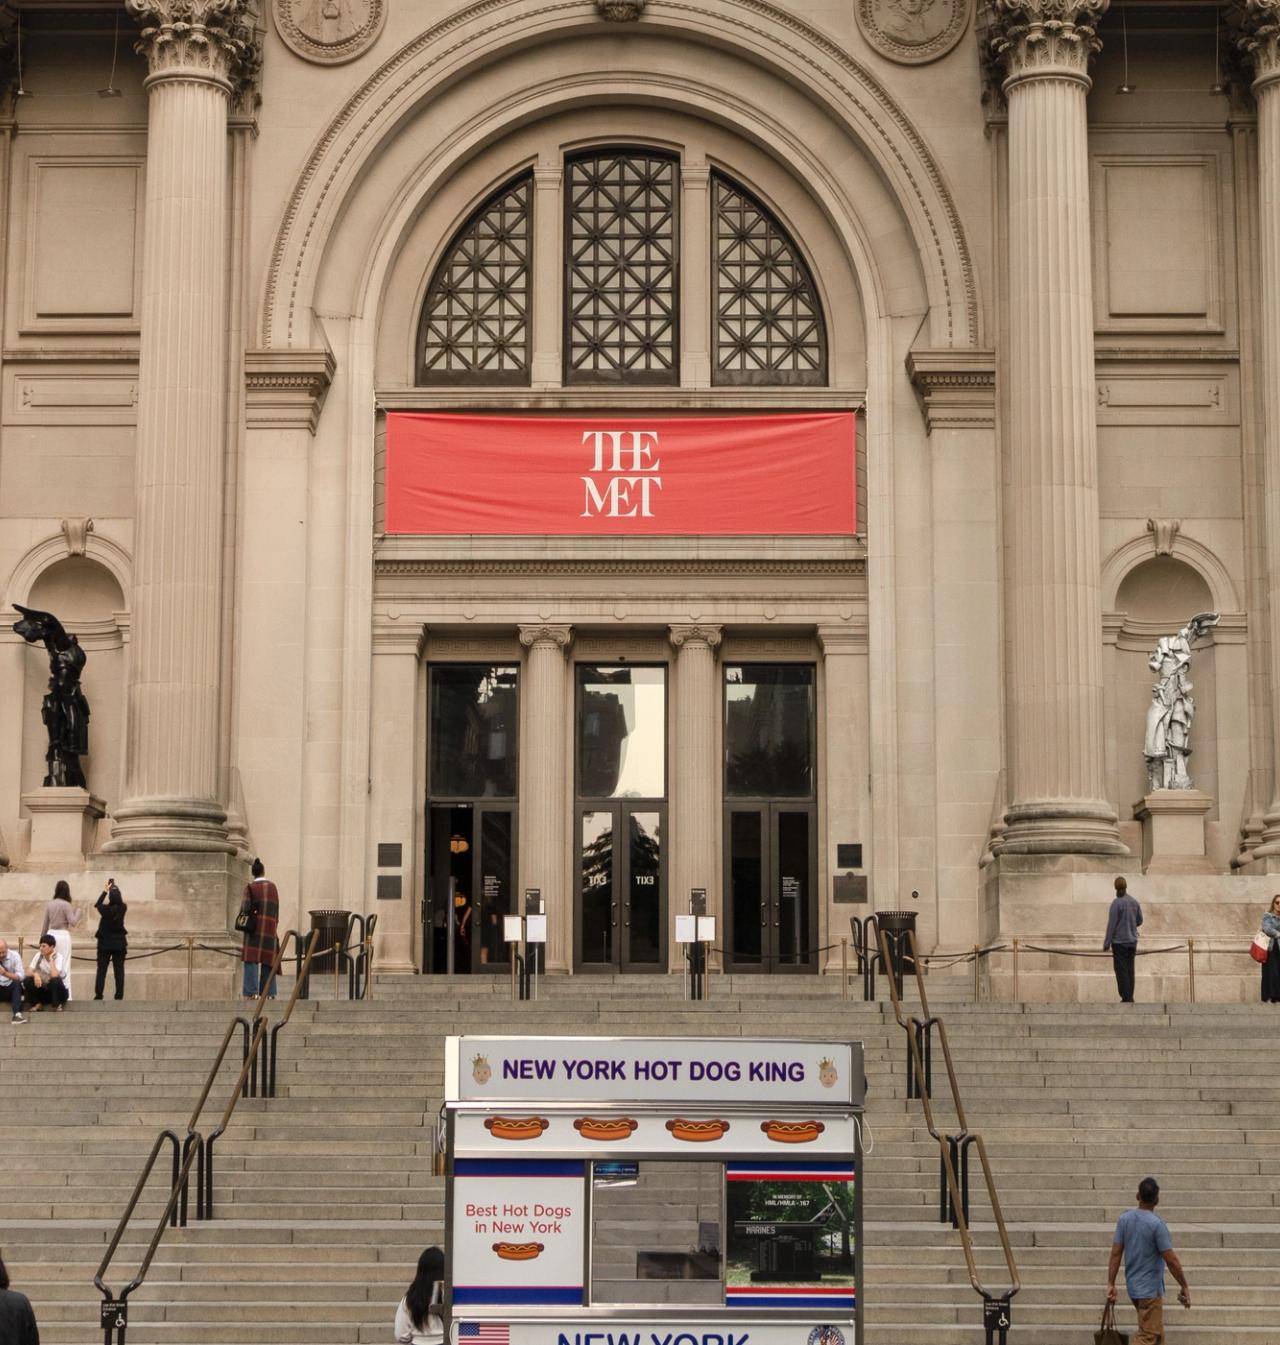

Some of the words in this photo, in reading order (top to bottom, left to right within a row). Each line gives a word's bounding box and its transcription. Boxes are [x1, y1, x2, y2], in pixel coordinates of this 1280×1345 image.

[582, 431, 660, 472] THE
[580, 476, 662, 517] MET
[502, 1059, 557, 1080] NEW
[561, 1059, 627, 1081] YORK
[633, 1060, 683, 1081] HOT
[689, 1061, 742, 1082] DOG
[748, 1061, 805, 1083] KING
[465, 1204, 498, 1217] Best
[502, 1204, 529, 1217] Hot
[534, 1204, 572, 1219] Dogs
[475, 1220, 487, 1233] in
[492, 1221, 525, 1233] New
[529, 1220, 562, 1233] York
[745, 1226, 776, 1234] MARINES
